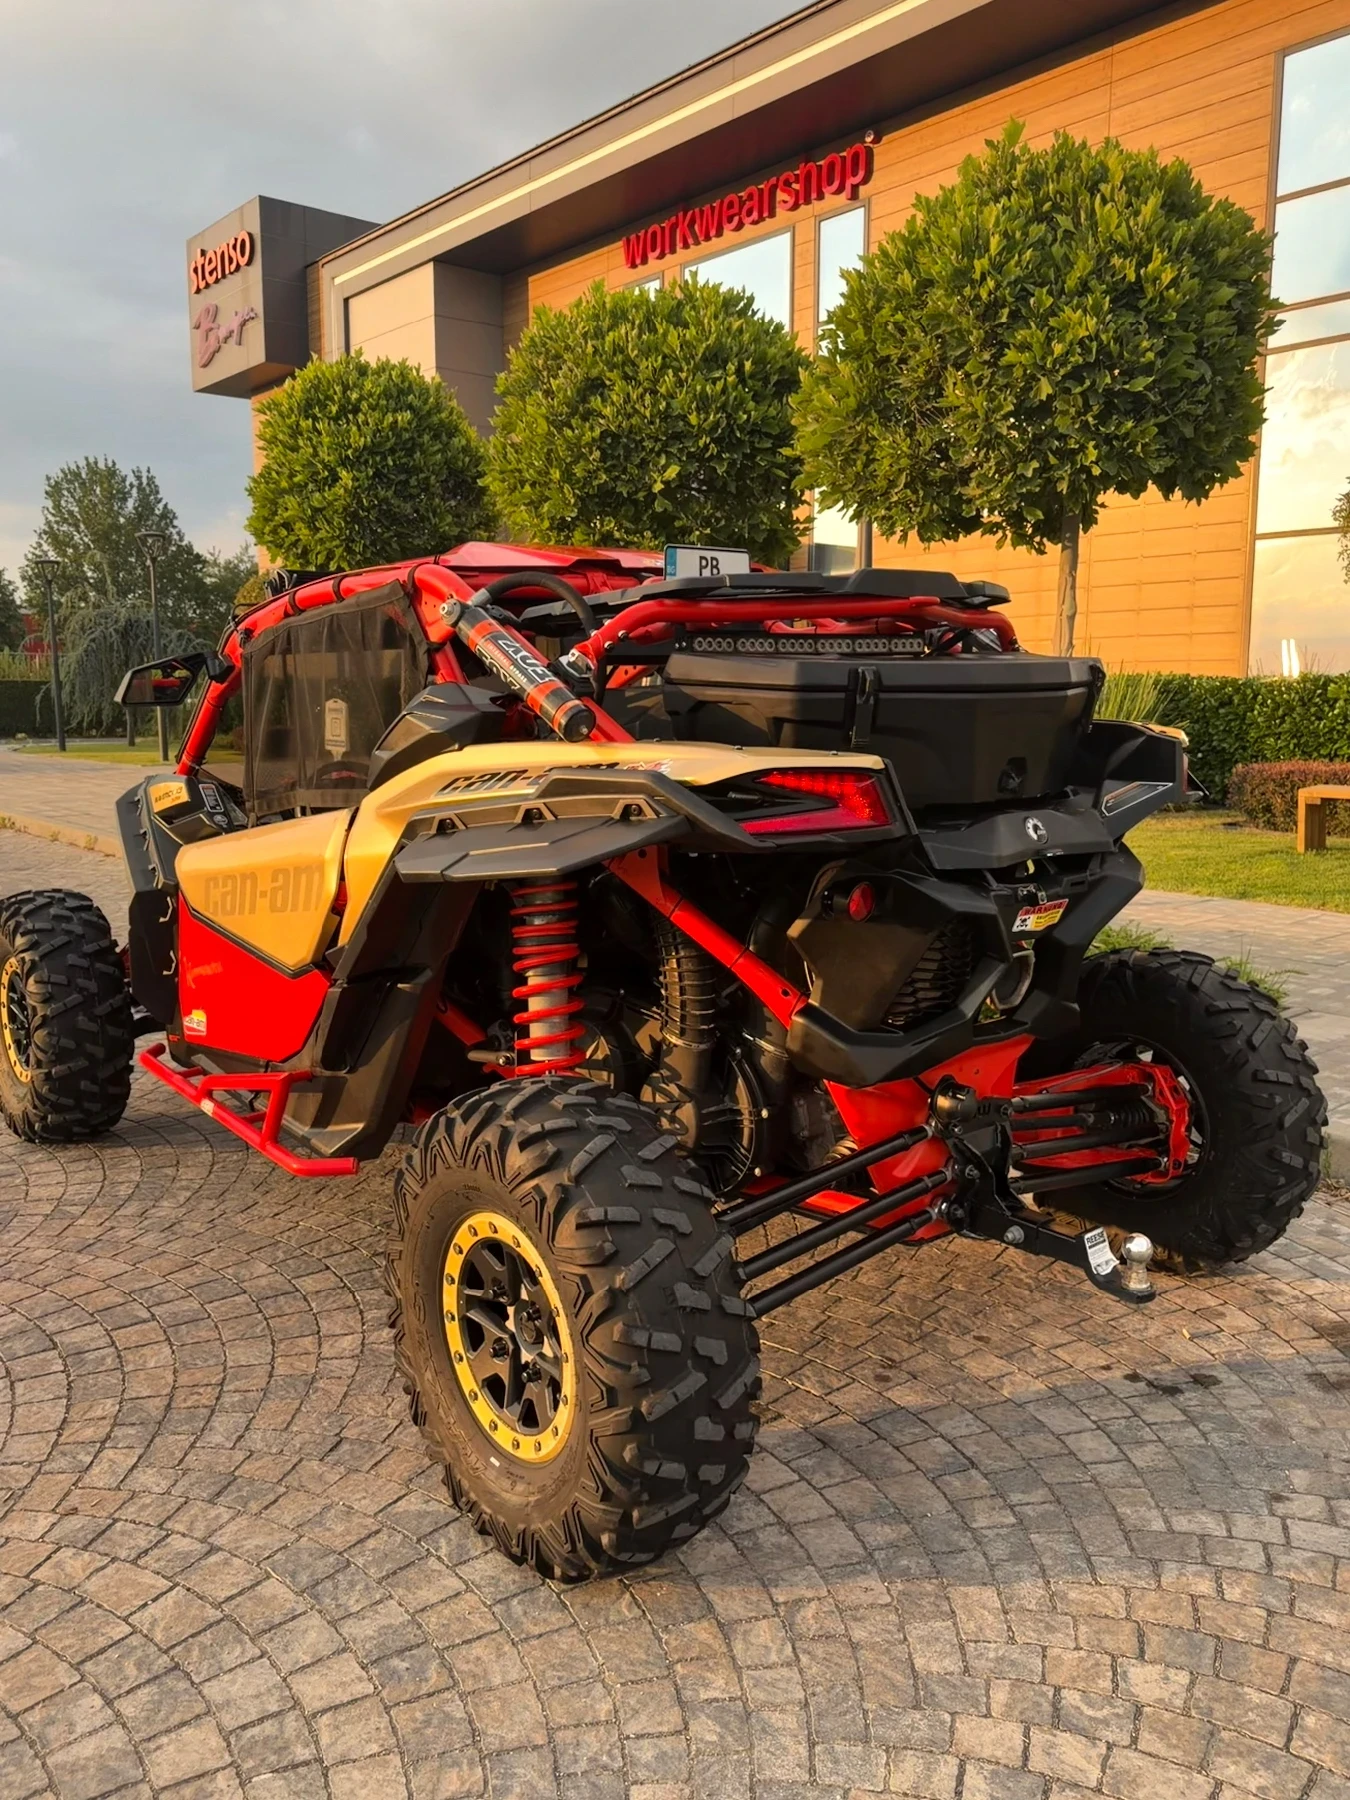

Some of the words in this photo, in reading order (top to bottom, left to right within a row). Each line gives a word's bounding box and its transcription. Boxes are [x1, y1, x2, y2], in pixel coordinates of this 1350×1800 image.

[189, 229, 254, 294] stenso
[698, 555, 721, 577] PB
[204, 864, 323, 918] can-am
